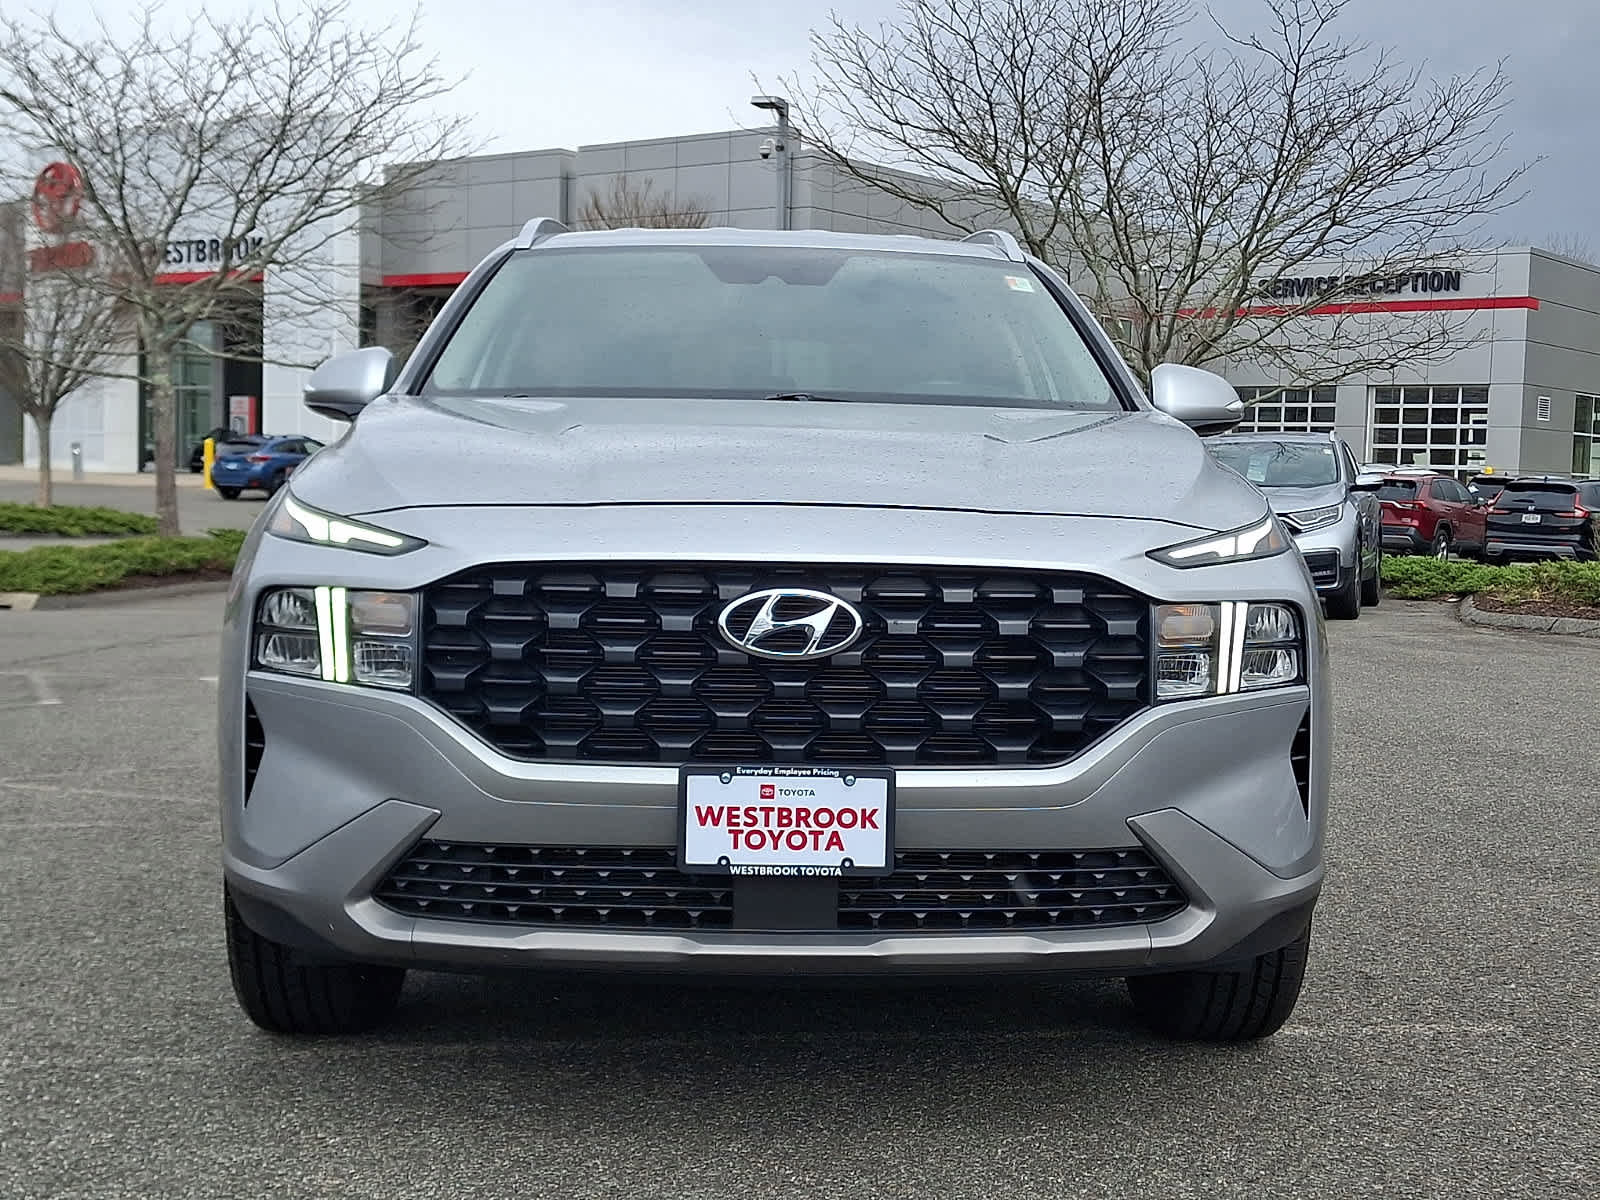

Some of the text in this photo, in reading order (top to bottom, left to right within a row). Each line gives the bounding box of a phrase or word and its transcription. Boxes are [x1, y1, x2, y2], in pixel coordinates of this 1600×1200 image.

[736, 767, 840, 778] Everyday Employee Pricing
[778, 788, 816, 797] TOYOTA
[694, 805, 880, 830] WESTBROOK
[727, 829, 845, 852] TOYOTA
[729, 865, 843, 877] WESTBROOK TOYOTA
